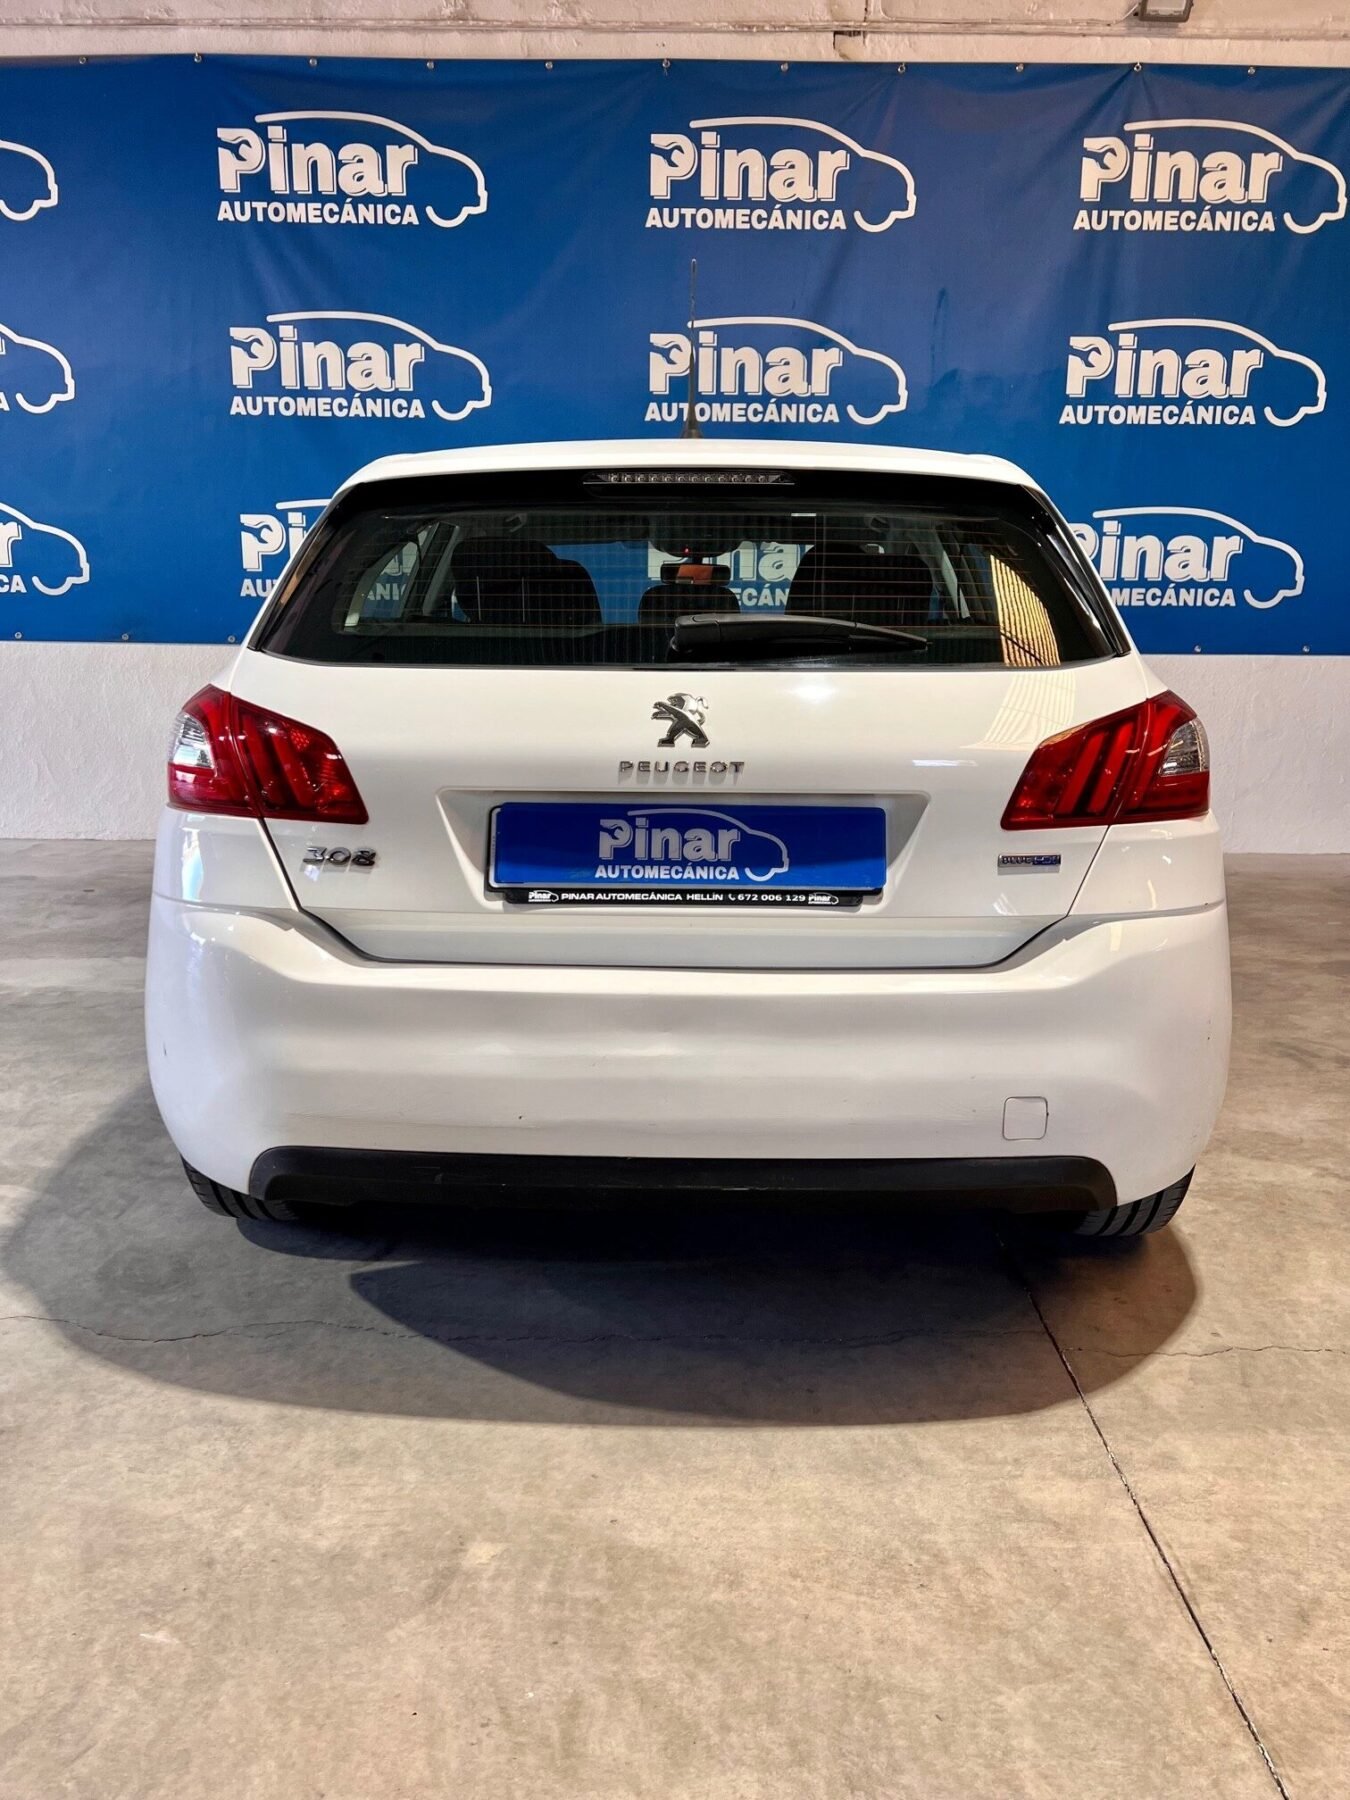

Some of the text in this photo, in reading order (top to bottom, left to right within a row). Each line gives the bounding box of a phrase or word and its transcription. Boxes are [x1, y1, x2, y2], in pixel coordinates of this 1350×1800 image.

[217, 126, 418, 196] Pinar
[649, 131, 850, 203] Pinar
[1080, 133, 1283, 204] Pinar
[217, 198, 419, 225] AUTOMECÁNICA
[645, 204, 847, 230] AUTOMECÁNICA
[1073, 206, 1276, 232] AUTOMECÁNICA
[229, 325, 425, 392] Pinar
[649, 331, 843, 397] Pinar
[1066, 333, 1263, 398] Pinar
[230, 393, 426, 418] AUTOMECÁNICA
[1059, 401, 1256, 425] AUTOMECÁNICA
[619, 760, 745, 773] PEUGEOT
[599, 817, 741, 862] Pinar
[303, 846, 376, 866] 308
[595, 862, 740, 880] AUTOMECÁNICA
[561, 892, 594, 901] PINAR
[596, 891, 683, 901] AUTOMECÁNICA
[686, 892, 723, 901] HELLÍN
[738, 893, 758, 902] 672
[761, 893, 782, 902] 006
[785, 894, 806, 902] 129
